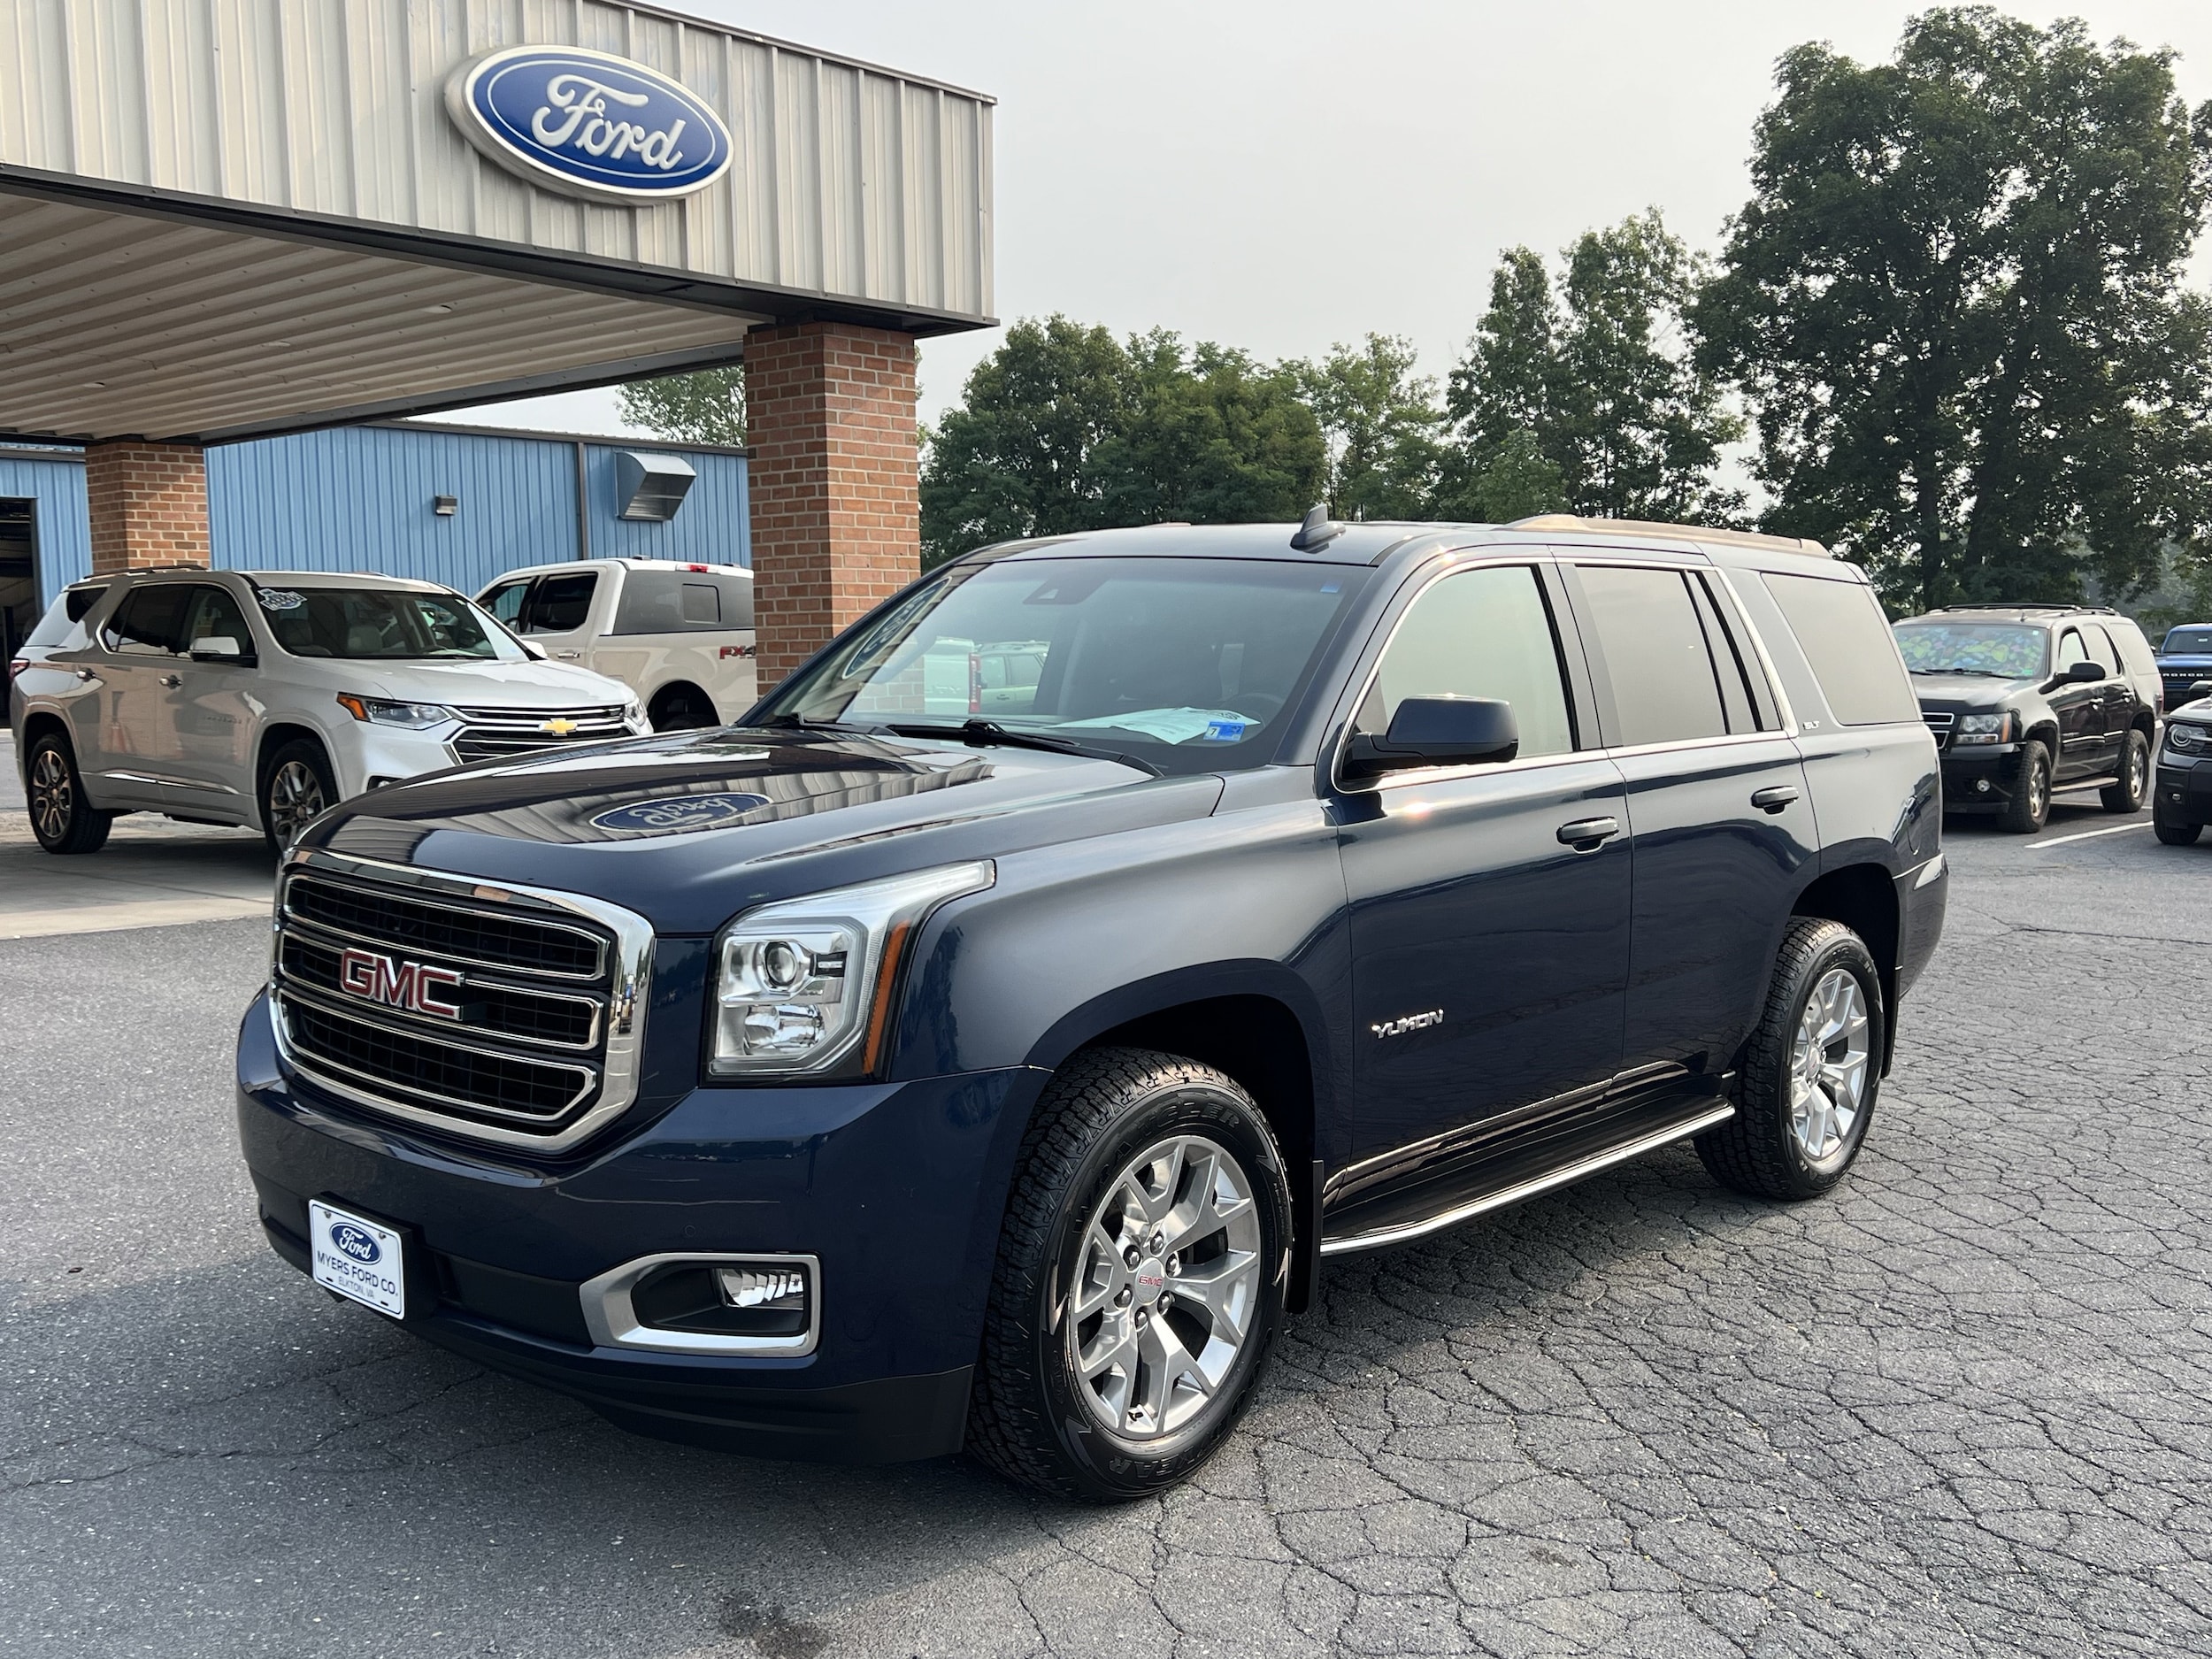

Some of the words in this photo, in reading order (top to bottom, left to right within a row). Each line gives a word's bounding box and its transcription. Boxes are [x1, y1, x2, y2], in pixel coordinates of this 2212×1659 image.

[532, 74, 685, 170] Ford
[341, 947, 465, 1021] GMC
[1371, 1009, 1444, 1039] YUKON
[339, 1227, 372, 1260] Ford
[317, 1250, 349, 1275] MYERS
[351, 1266, 379, 1287] FORD
[380, 1279, 399, 1297] CO.
[1139, 1274, 1163, 1287] GMC
